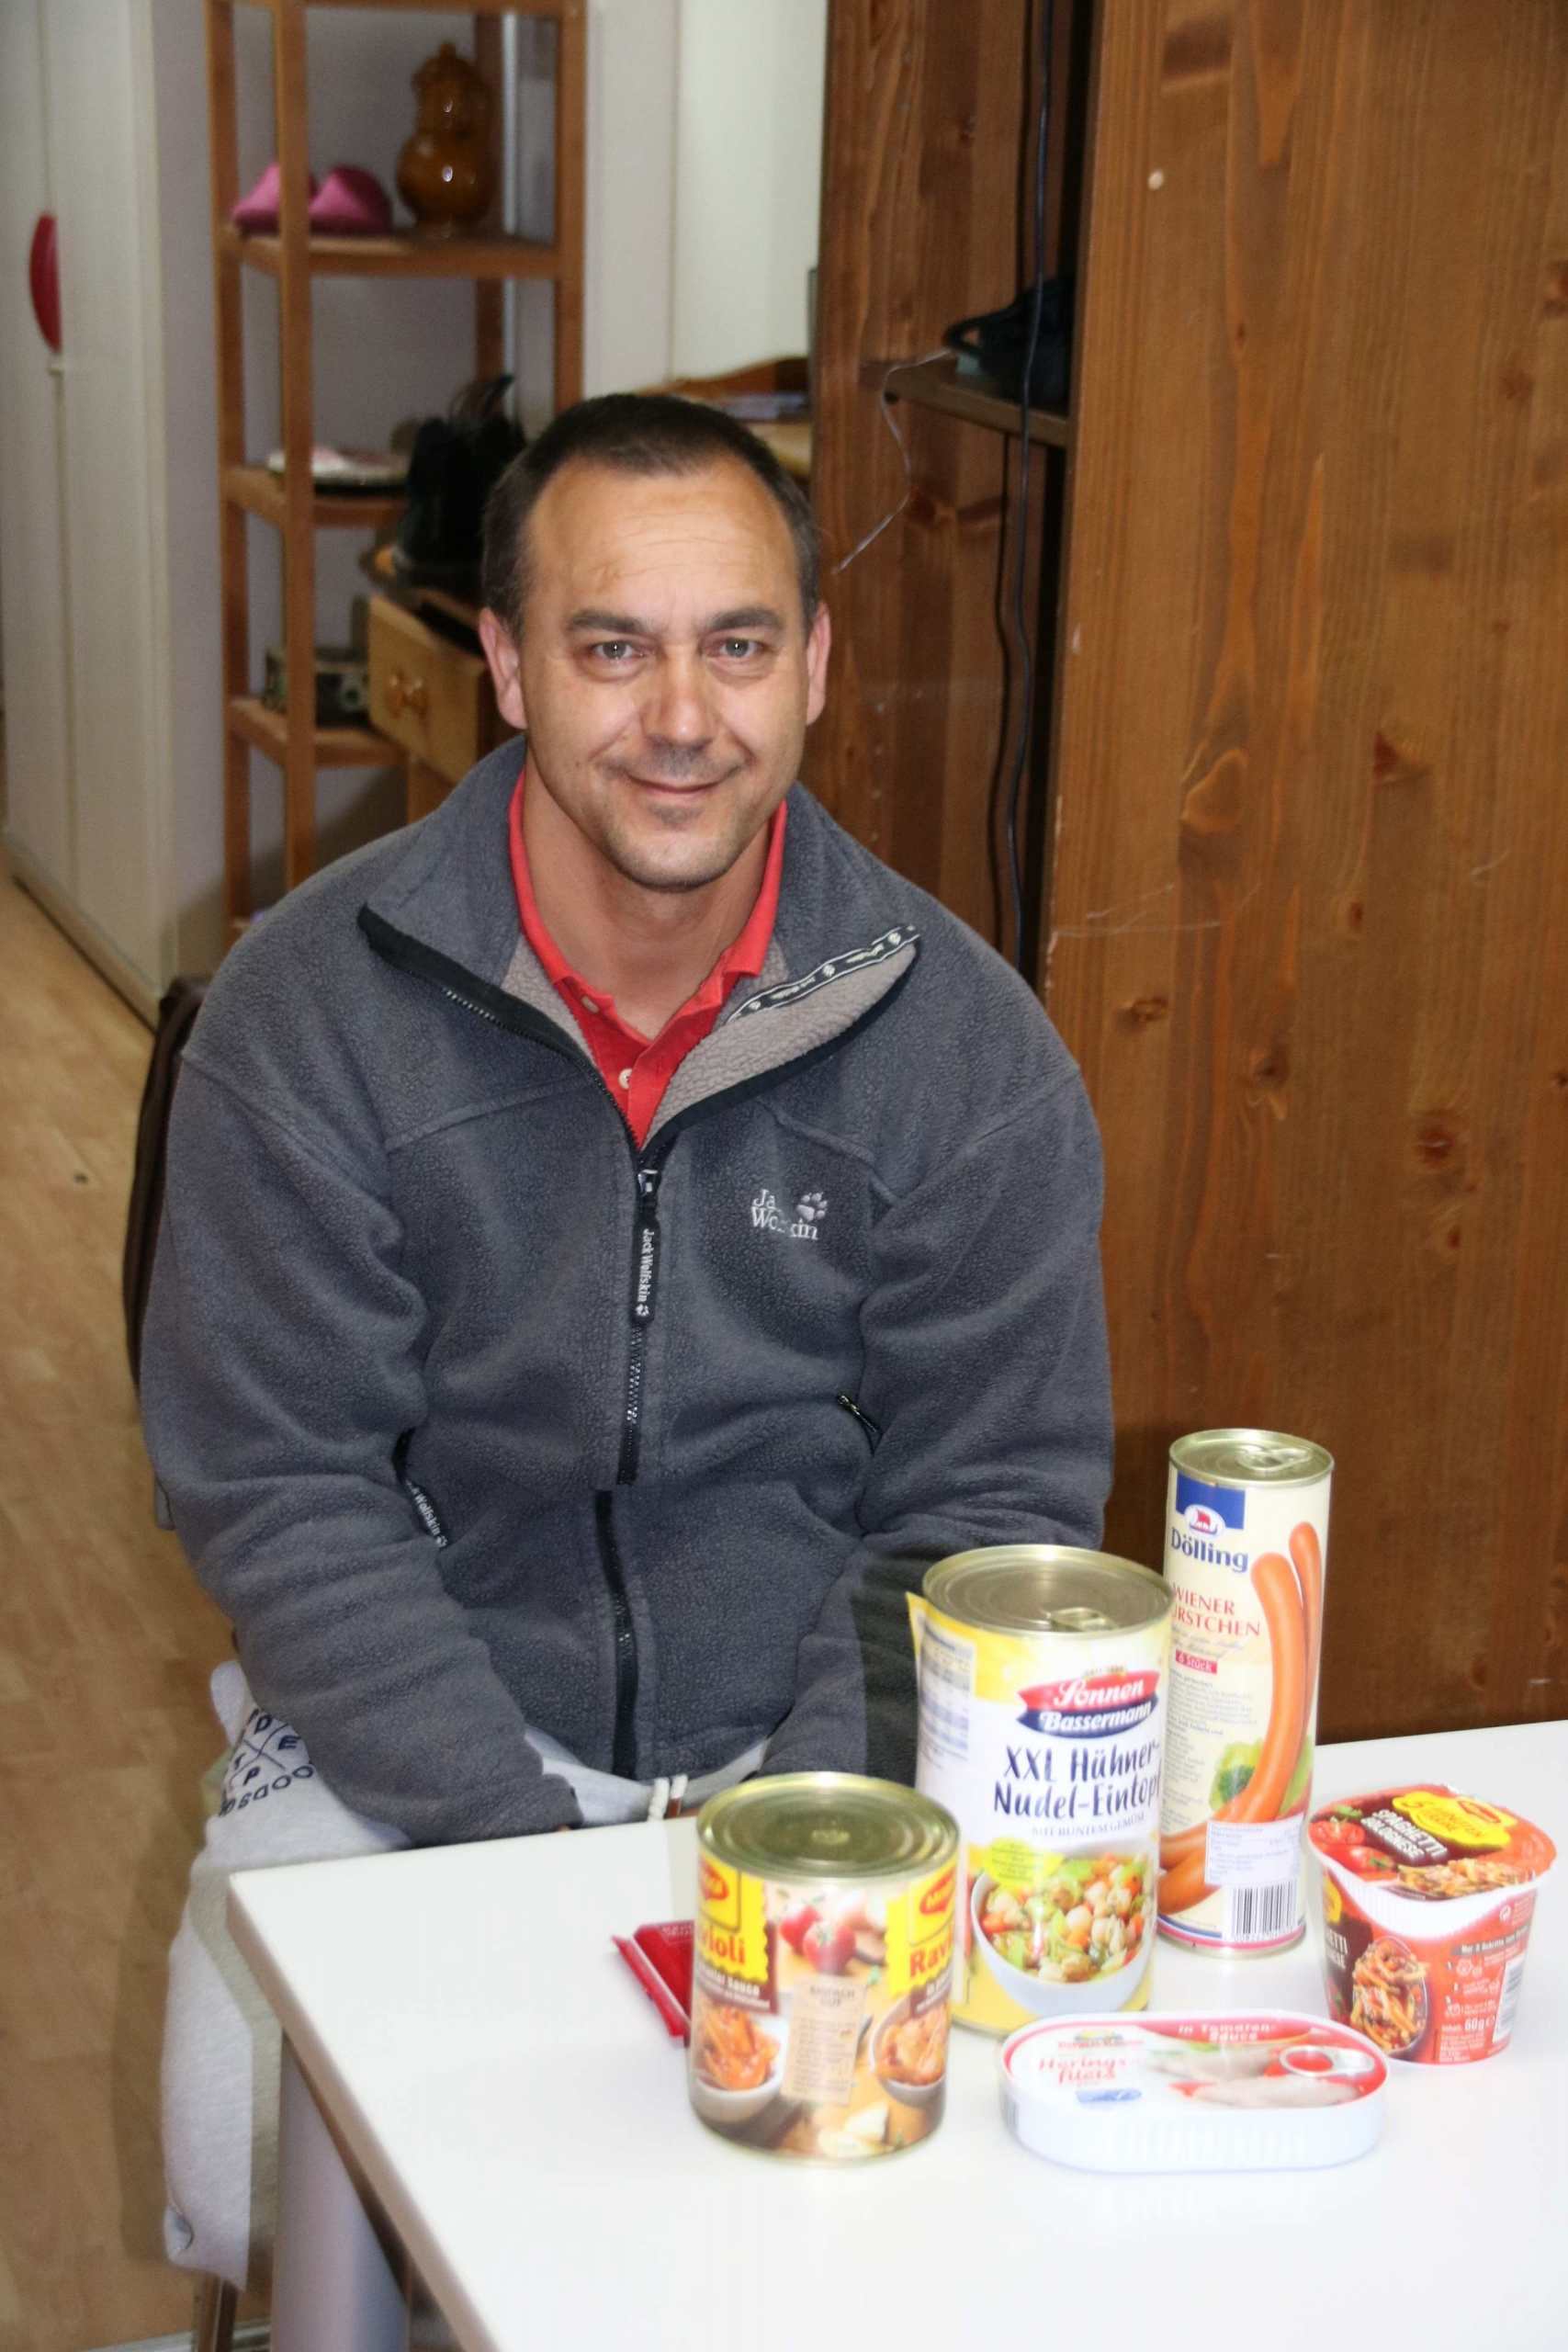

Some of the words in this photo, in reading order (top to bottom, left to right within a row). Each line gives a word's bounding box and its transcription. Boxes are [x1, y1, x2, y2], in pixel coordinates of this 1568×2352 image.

[642, 1228, 655, 1254] Jack
[637, 1254, 654, 1303] Wolfskin
[1170, 1526, 1249, 1574] Dölling
[1054, 1678, 1145, 1707] Sonnen
[1040, 1700, 1152, 1732] Bassermann
[1004, 1744, 1057, 1782] XXL
